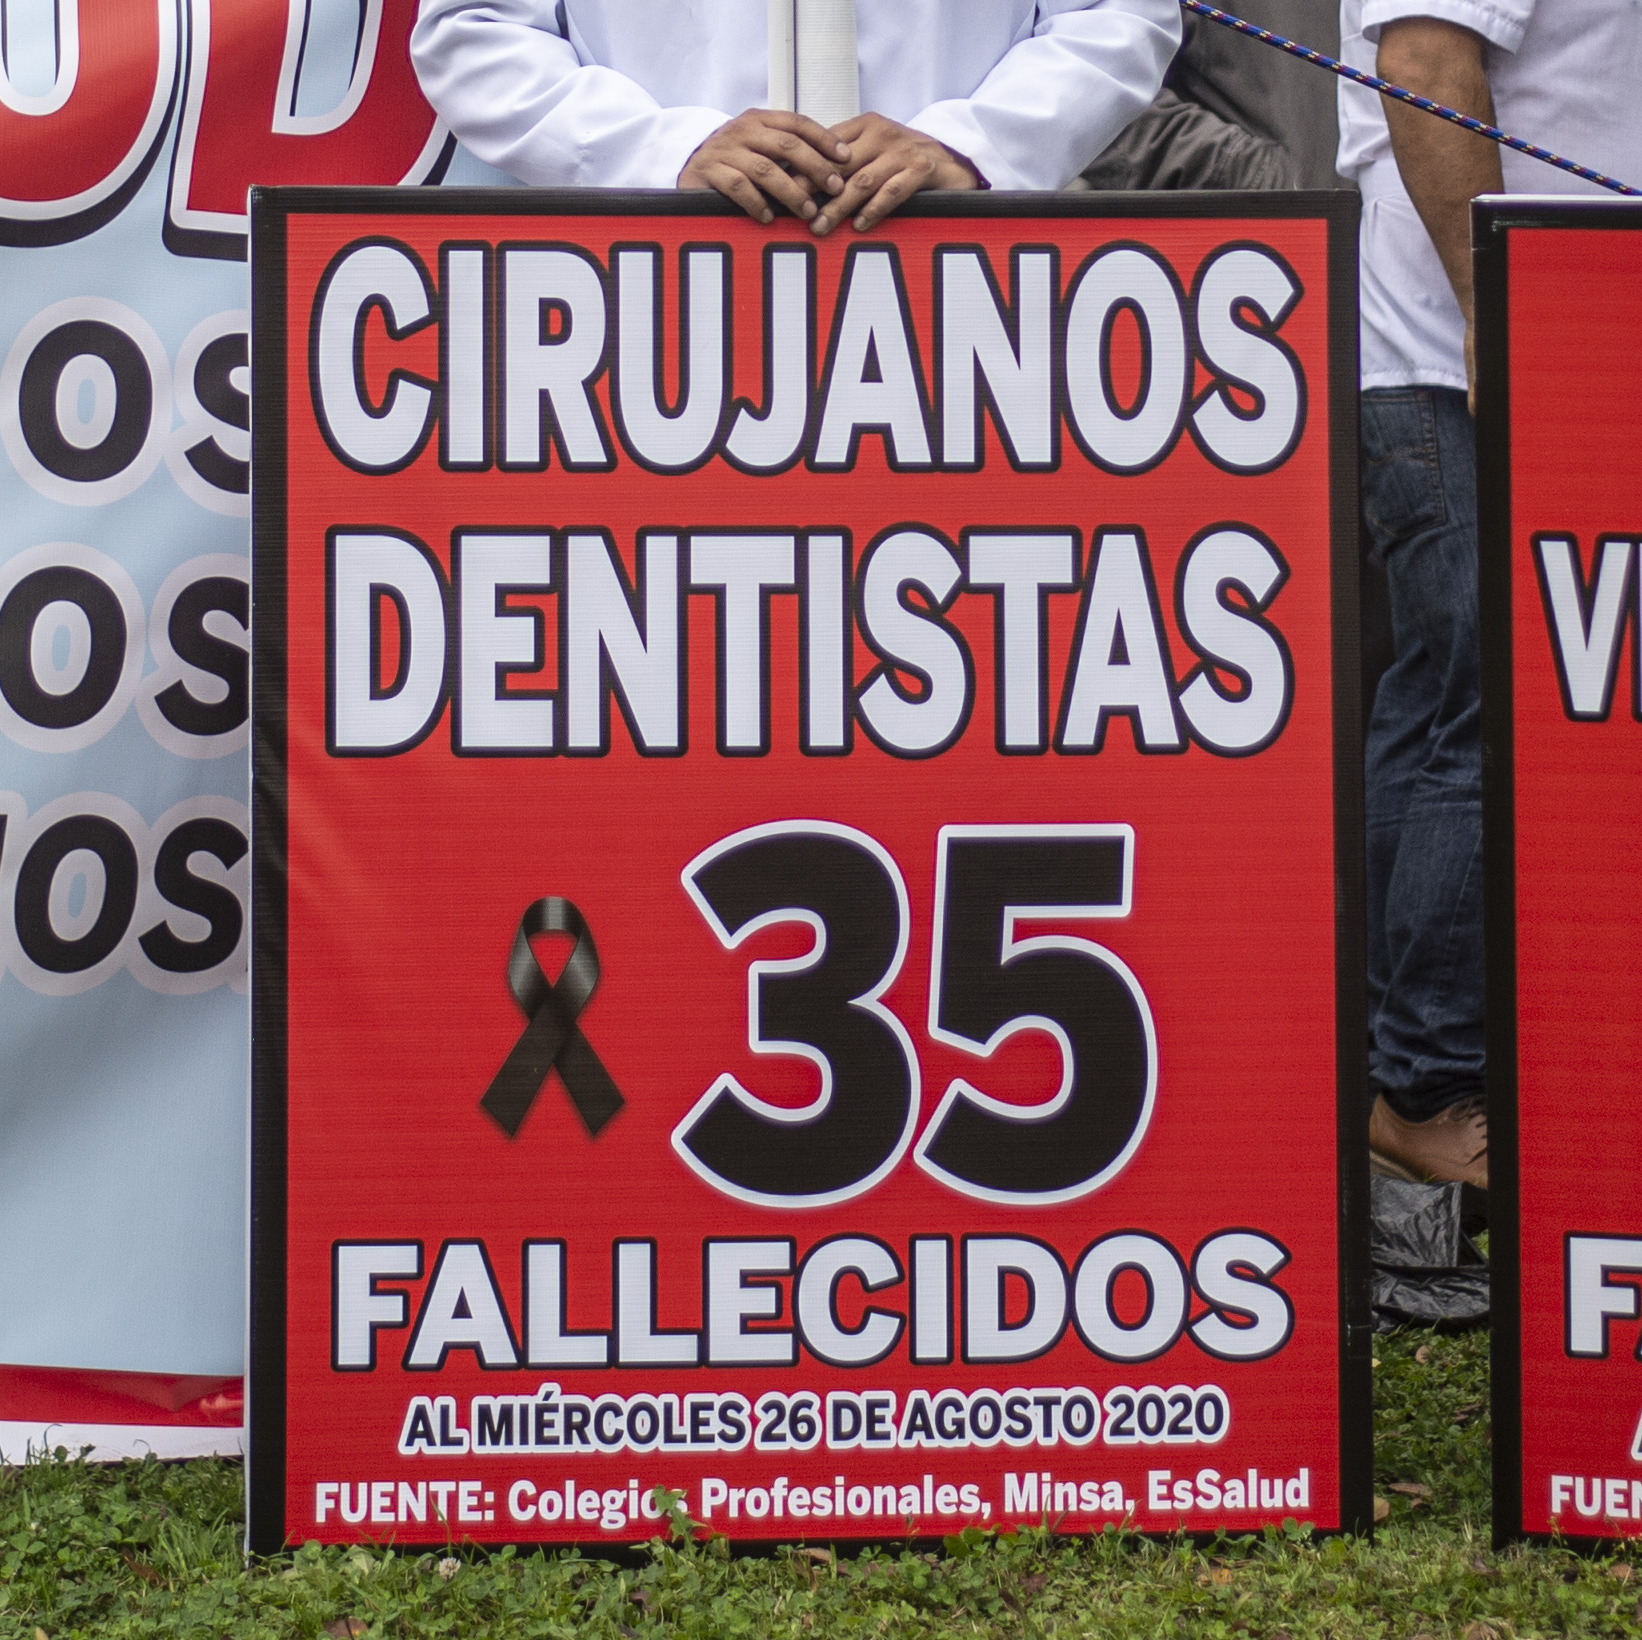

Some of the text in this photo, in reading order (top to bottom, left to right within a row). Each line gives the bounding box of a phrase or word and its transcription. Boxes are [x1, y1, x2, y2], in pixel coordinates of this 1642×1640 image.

[313, 240, 1307, 472] CIRUJANOS
[329, 526, 1293, 756] DENTISTAS
[671, 818, 1158, 1208] 35
[333, 1231, 1293, 1368] FALLECIDOS
[314, 1478, 495, 1523] FUENTE:
[700, 1474, 992, 1520] Profesionales,
[1003, 1470, 1136, 1518] Minsa,
[1146, 1466, 1310, 1512] EsSalud
[402, 1387, 1227, 1450] AL MIÉRCOLES 26 DE AGOSTO 2020
